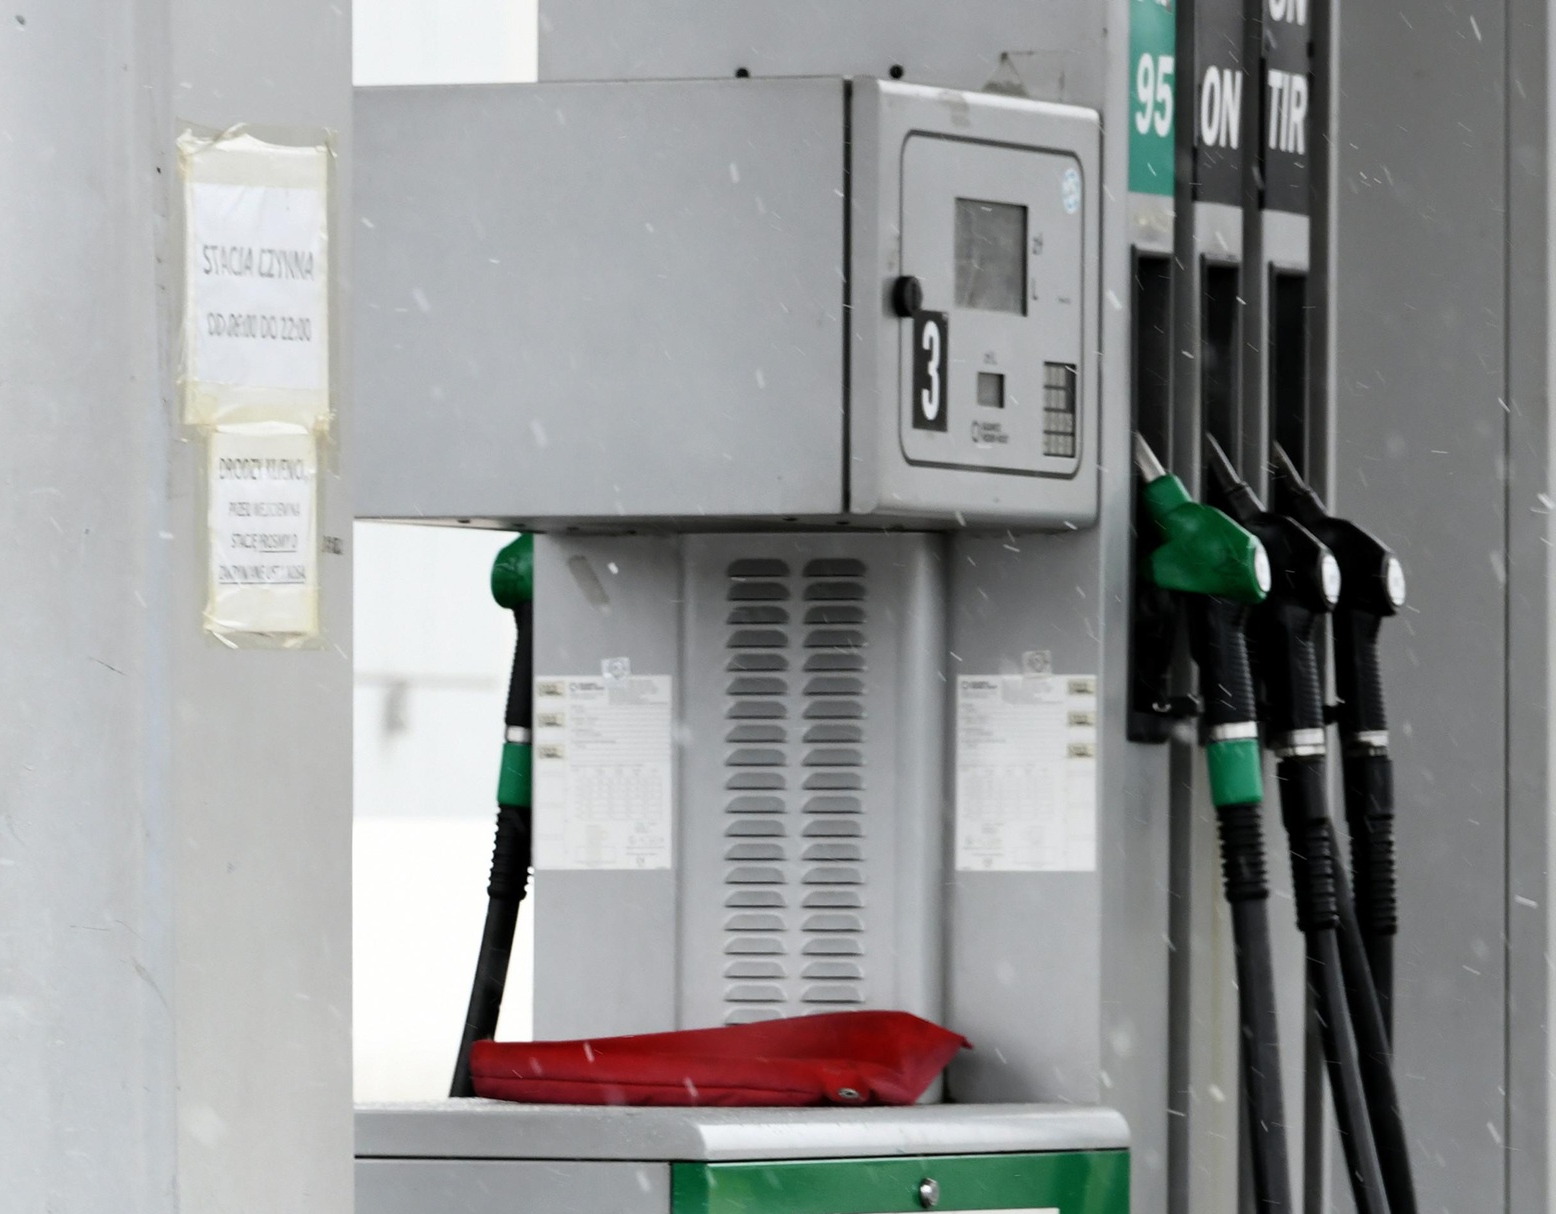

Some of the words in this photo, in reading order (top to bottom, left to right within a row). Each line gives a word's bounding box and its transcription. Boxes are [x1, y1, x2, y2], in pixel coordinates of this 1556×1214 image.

[1134, 52, 1175, 138] 95
[1200, 65, 1243, 150] ON
[1267, 68, 1308, 155] TIR
[921, 320, 942, 421] 3
